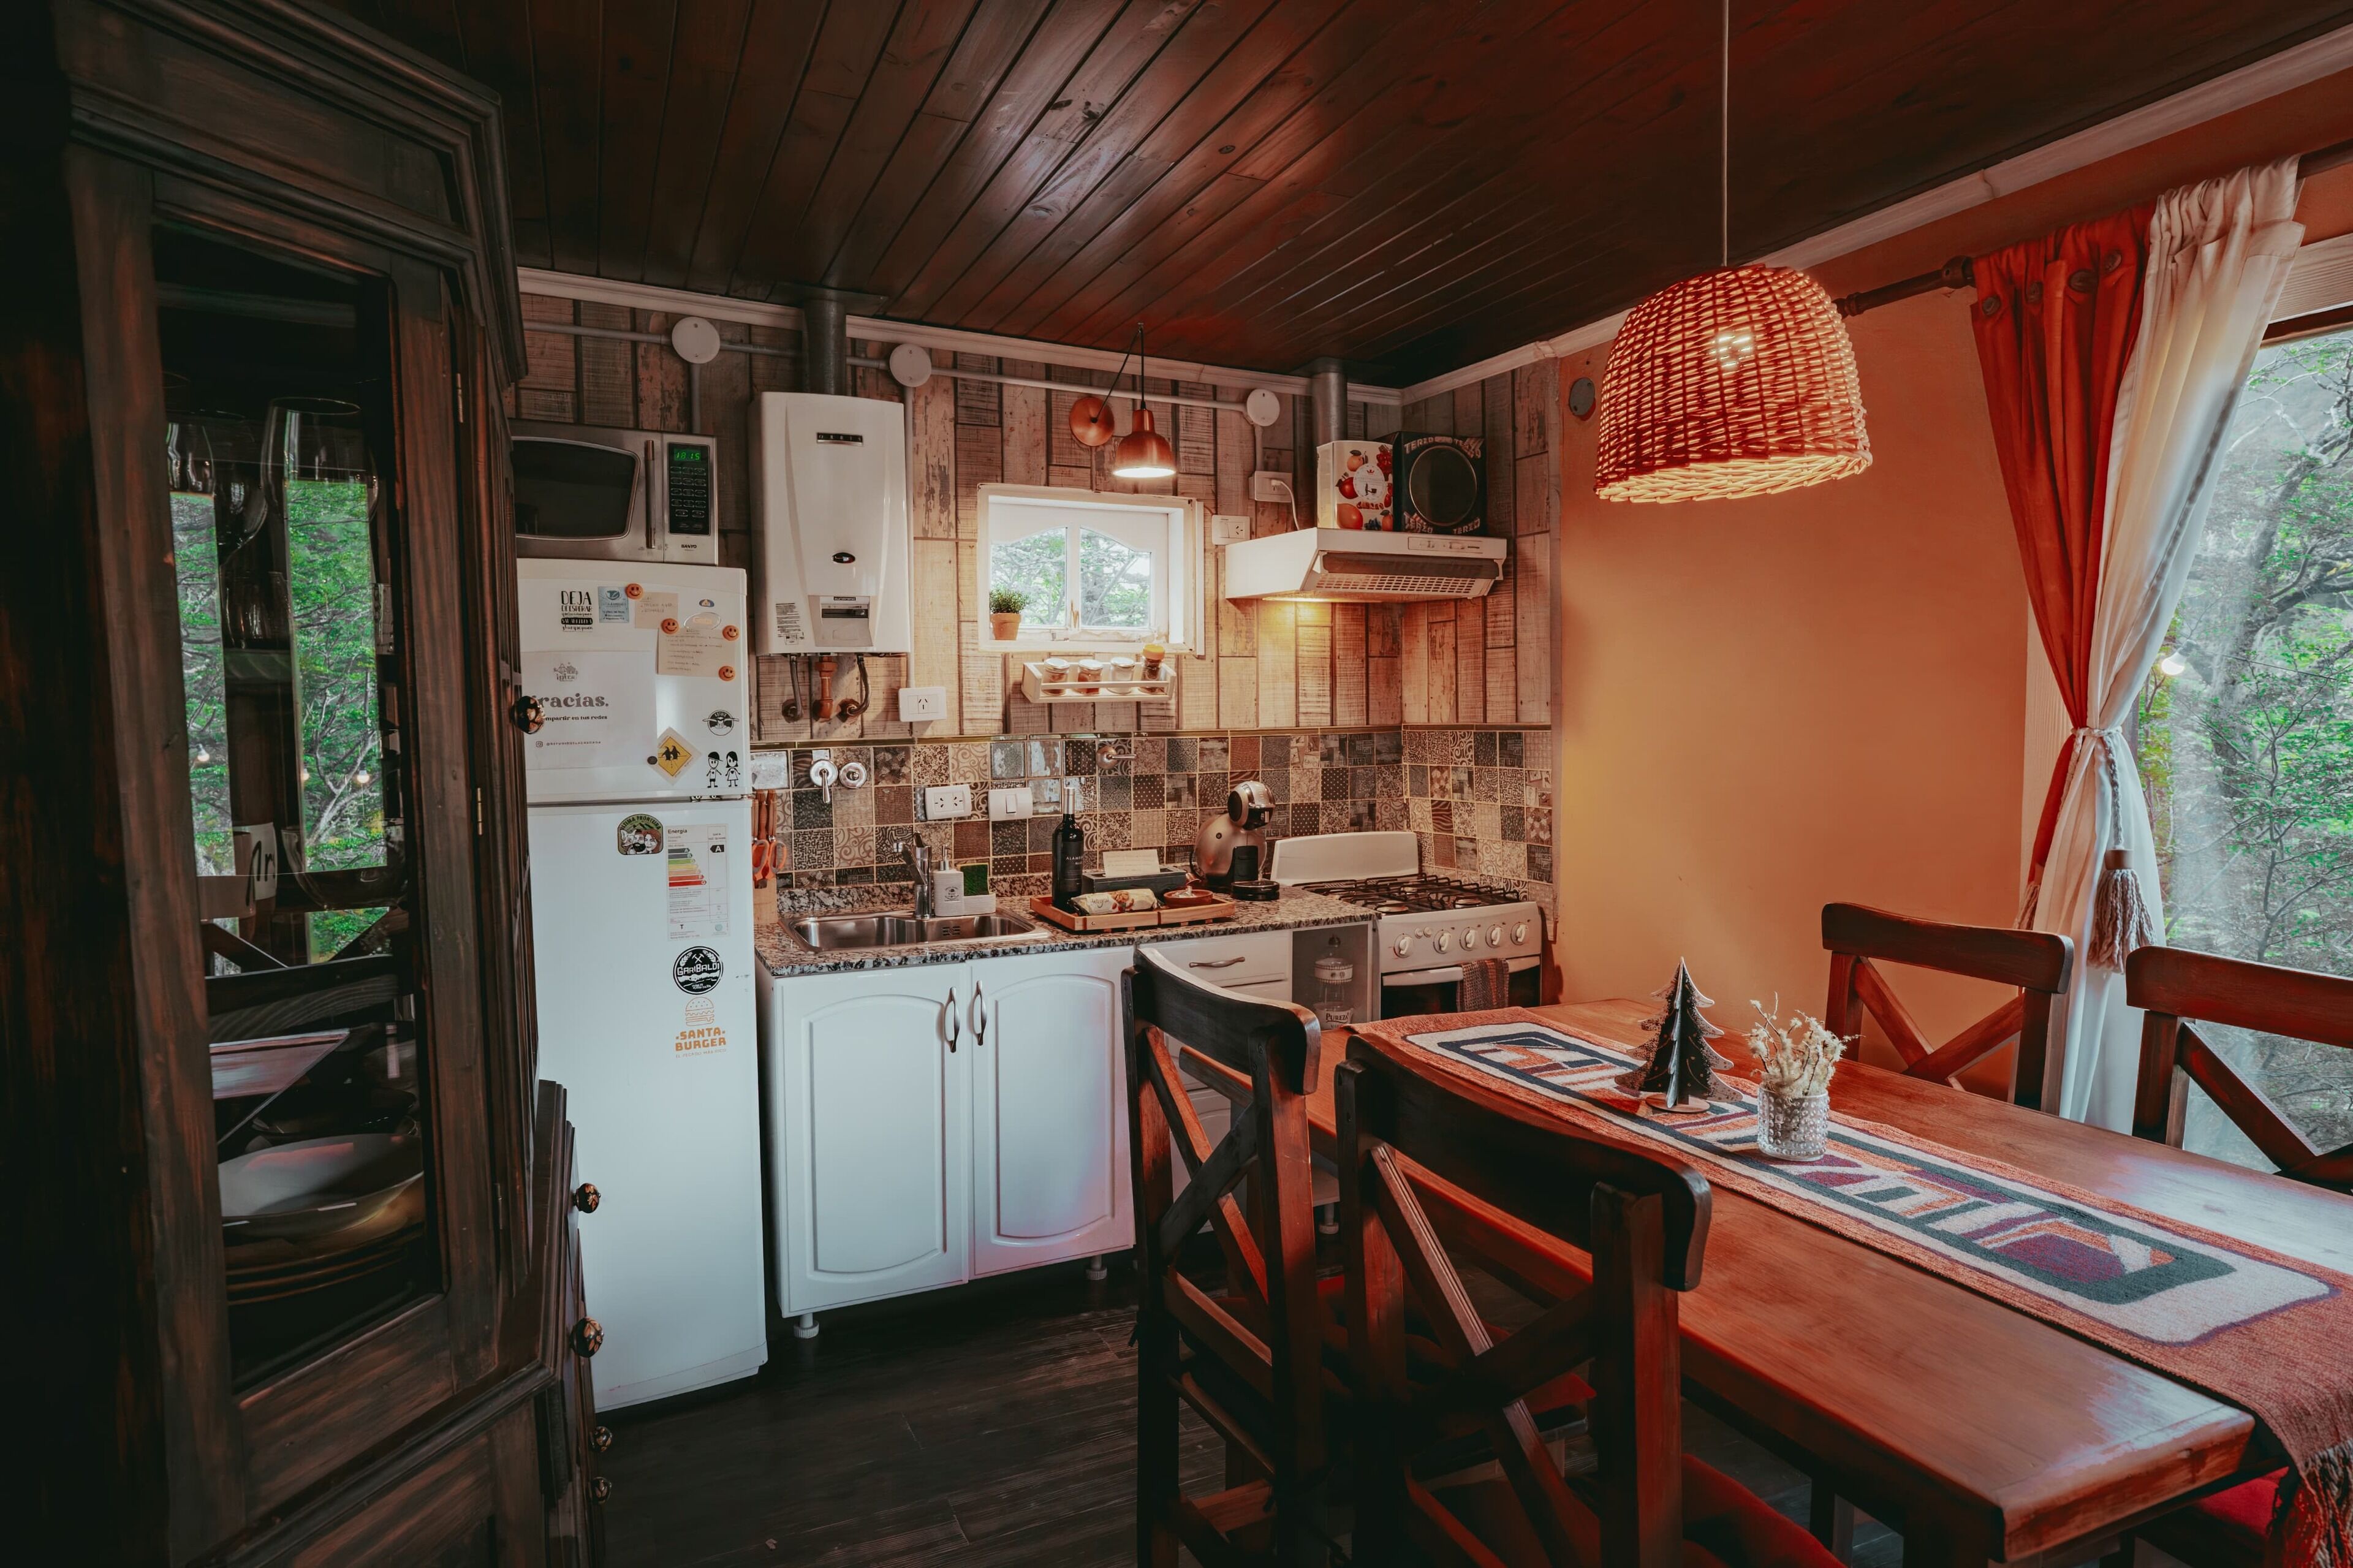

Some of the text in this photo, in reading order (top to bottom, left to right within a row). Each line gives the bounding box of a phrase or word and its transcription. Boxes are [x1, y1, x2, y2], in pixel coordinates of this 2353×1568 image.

[561, 591, 592, 605] DEJA
[539, 693, 609, 708] racias.
[675, 1037, 726, 1051] BURGER
